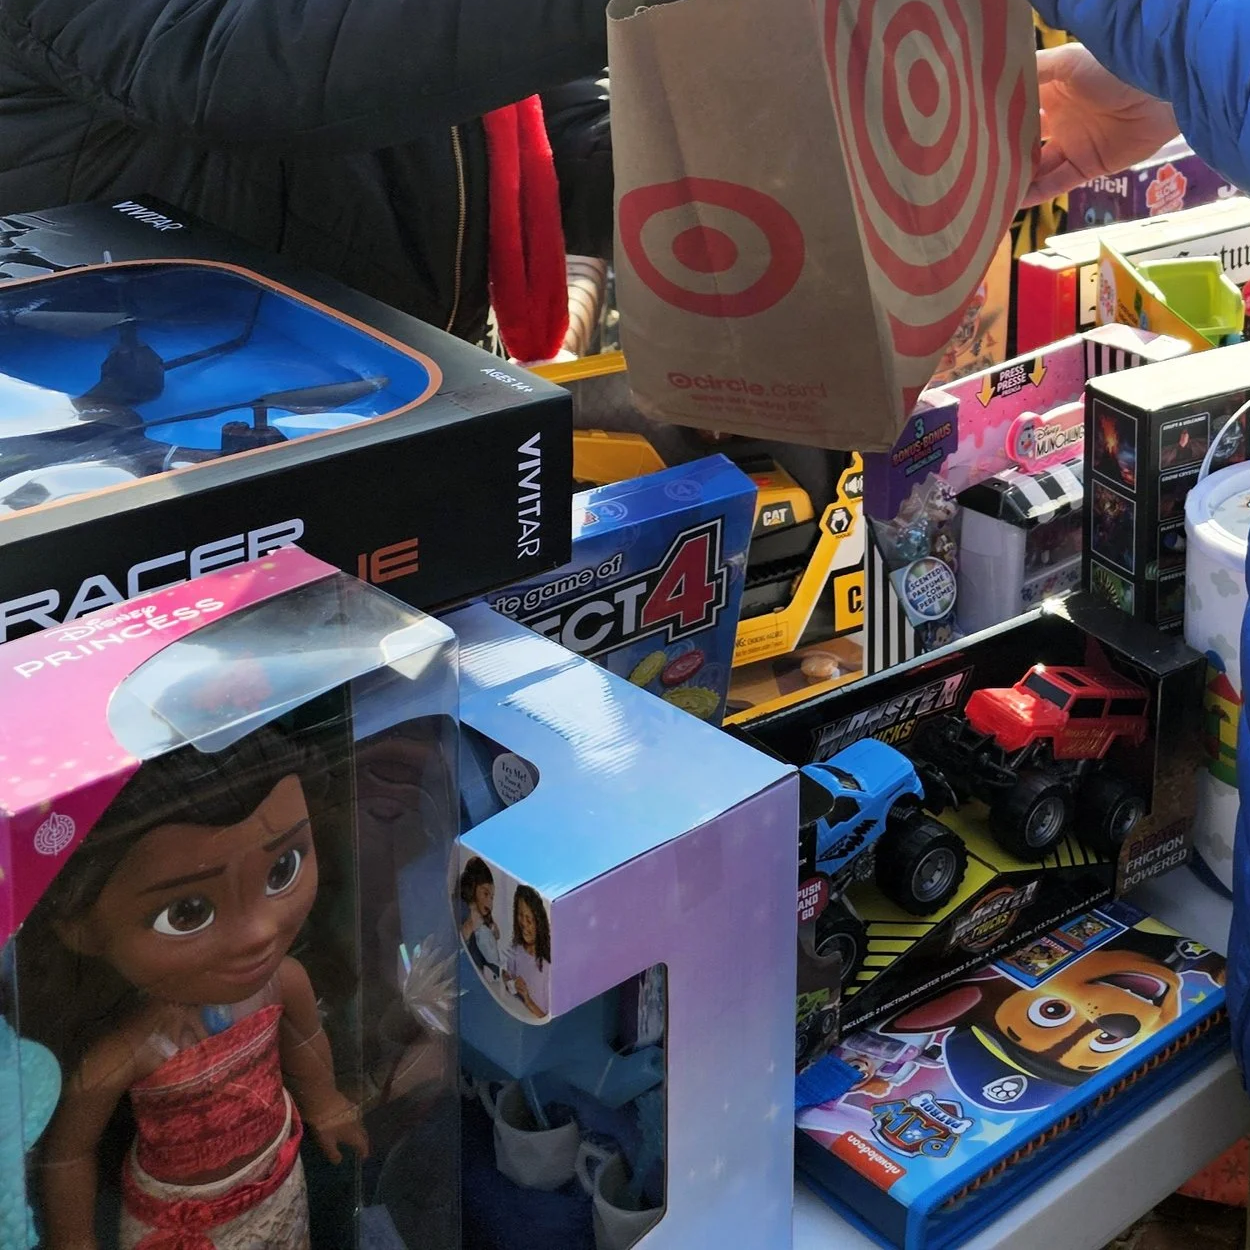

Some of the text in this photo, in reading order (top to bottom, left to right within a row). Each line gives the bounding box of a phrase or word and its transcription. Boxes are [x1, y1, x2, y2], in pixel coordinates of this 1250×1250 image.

[112, 201, 183, 231] VIVITAR
[480, 367, 534, 393] AGES 14+
[997, 373, 1027, 393] PRESSE
[1000, 364, 1025, 381] PRESS
[915, 418, 924, 437] 3
[517, 432, 541, 559] VIVITAR
[762, 508, 788, 526] CAT
[524, 569, 593, 610] game
[597, 553, 622, 579] of
[641, 532, 716, 628] 4
[926, 585, 941, 597] CON
[13, 597, 225, 680] PRINCESS
[813, 673, 964, 761] MONSTER
[1123, 849, 1187, 889] POWERED
[1125, 834, 1184, 873] FRICTION
[797, 880, 822, 901] PUSH
[797, 893, 819, 912] AND
[802, 907, 815, 921] GO
[881, 993, 909, 1012] FRICTION
[910, 978, 940, 998] MONSTER
[941, 965, 965, 982] TRUCKS
[871, 1100, 960, 1158] PAW
[920, 1098, 964, 1130] PATROL
[847, 1134, 900, 1174] nickelodeon
